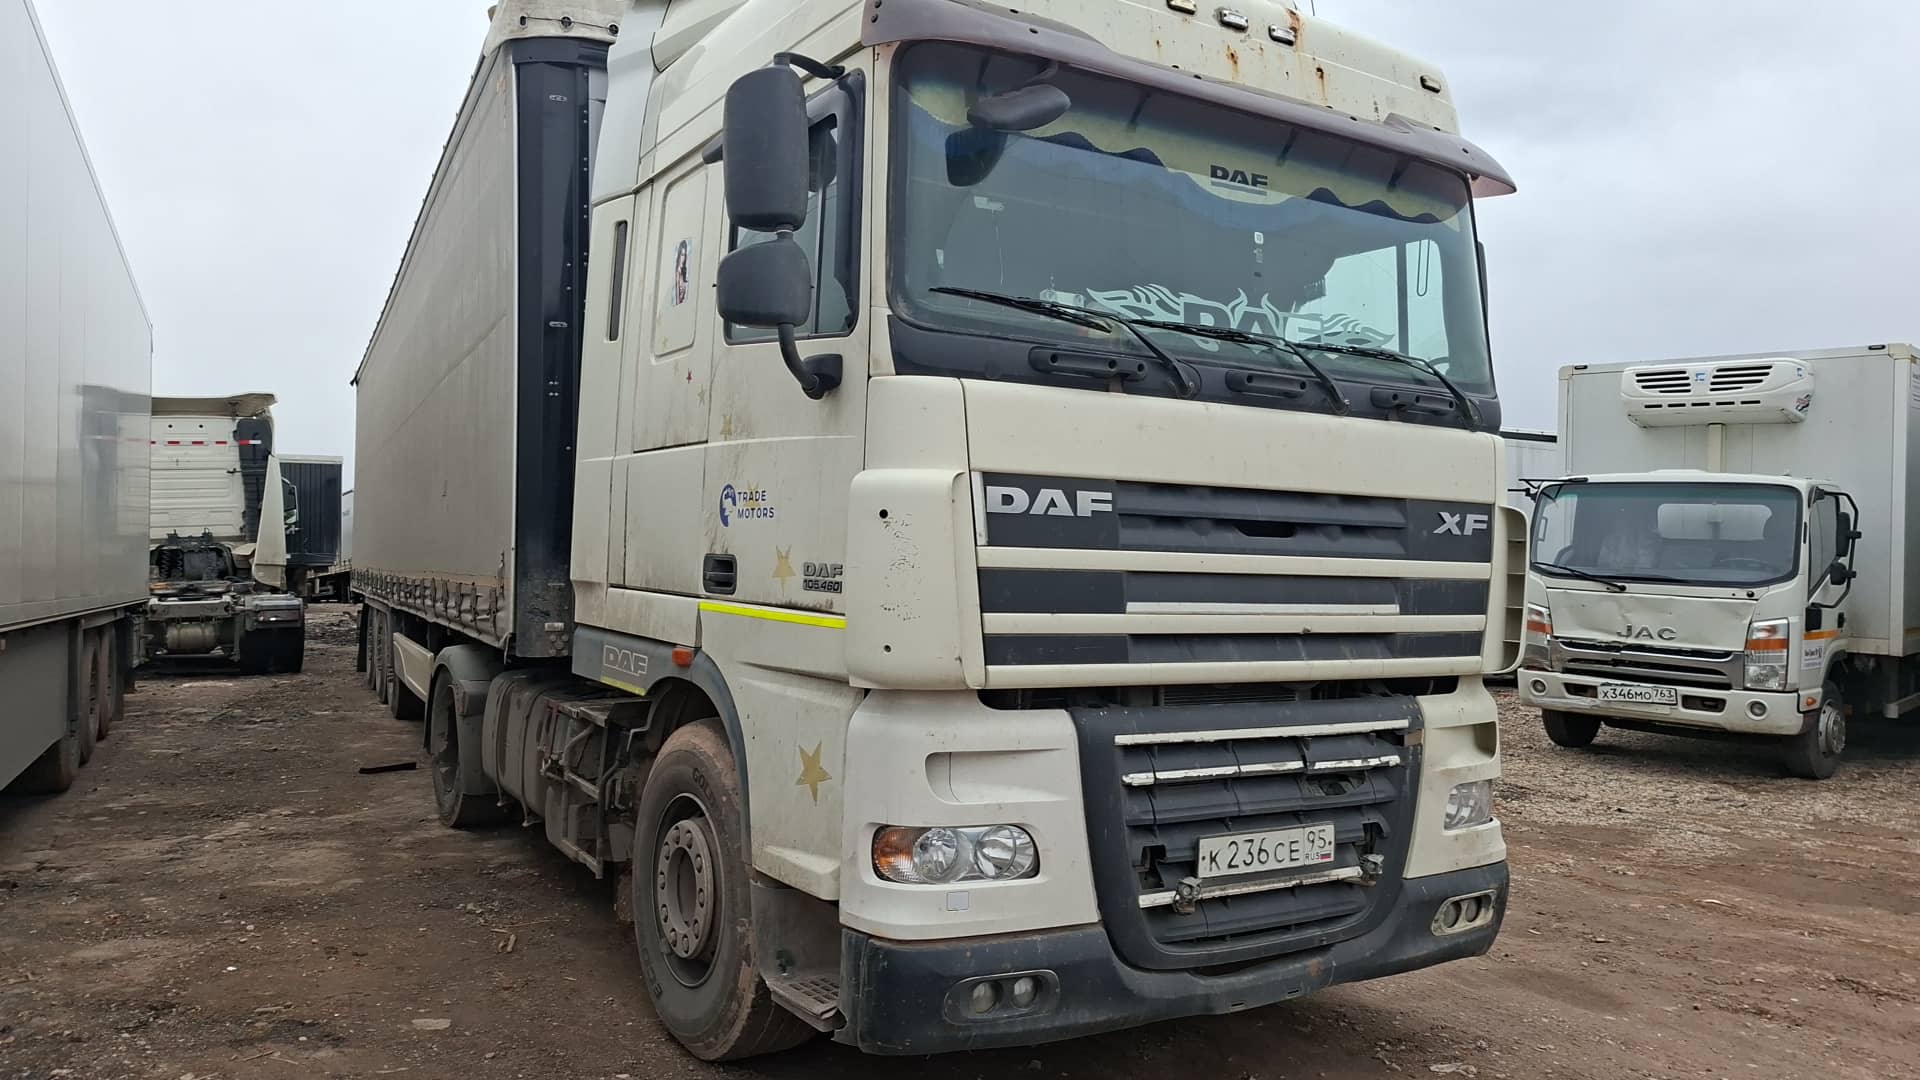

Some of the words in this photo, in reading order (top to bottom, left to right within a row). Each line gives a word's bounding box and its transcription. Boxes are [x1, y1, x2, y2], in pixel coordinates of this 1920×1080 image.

[1209, 164, 1268, 187] DAF
[737, 490, 767, 502] TRADE
[986, 485, 1113, 517] DAF
[737, 507, 775, 519] MOTORS
[1432, 511, 1489, 536] XF
[803, 562, 843, 578] DAF
[1616, 624, 1677, 641] JAC
[603, 645, 649, 677] DAF
[1307, 829, 1327, 850] 95
[1305, 853, 1320, 862] RUS
